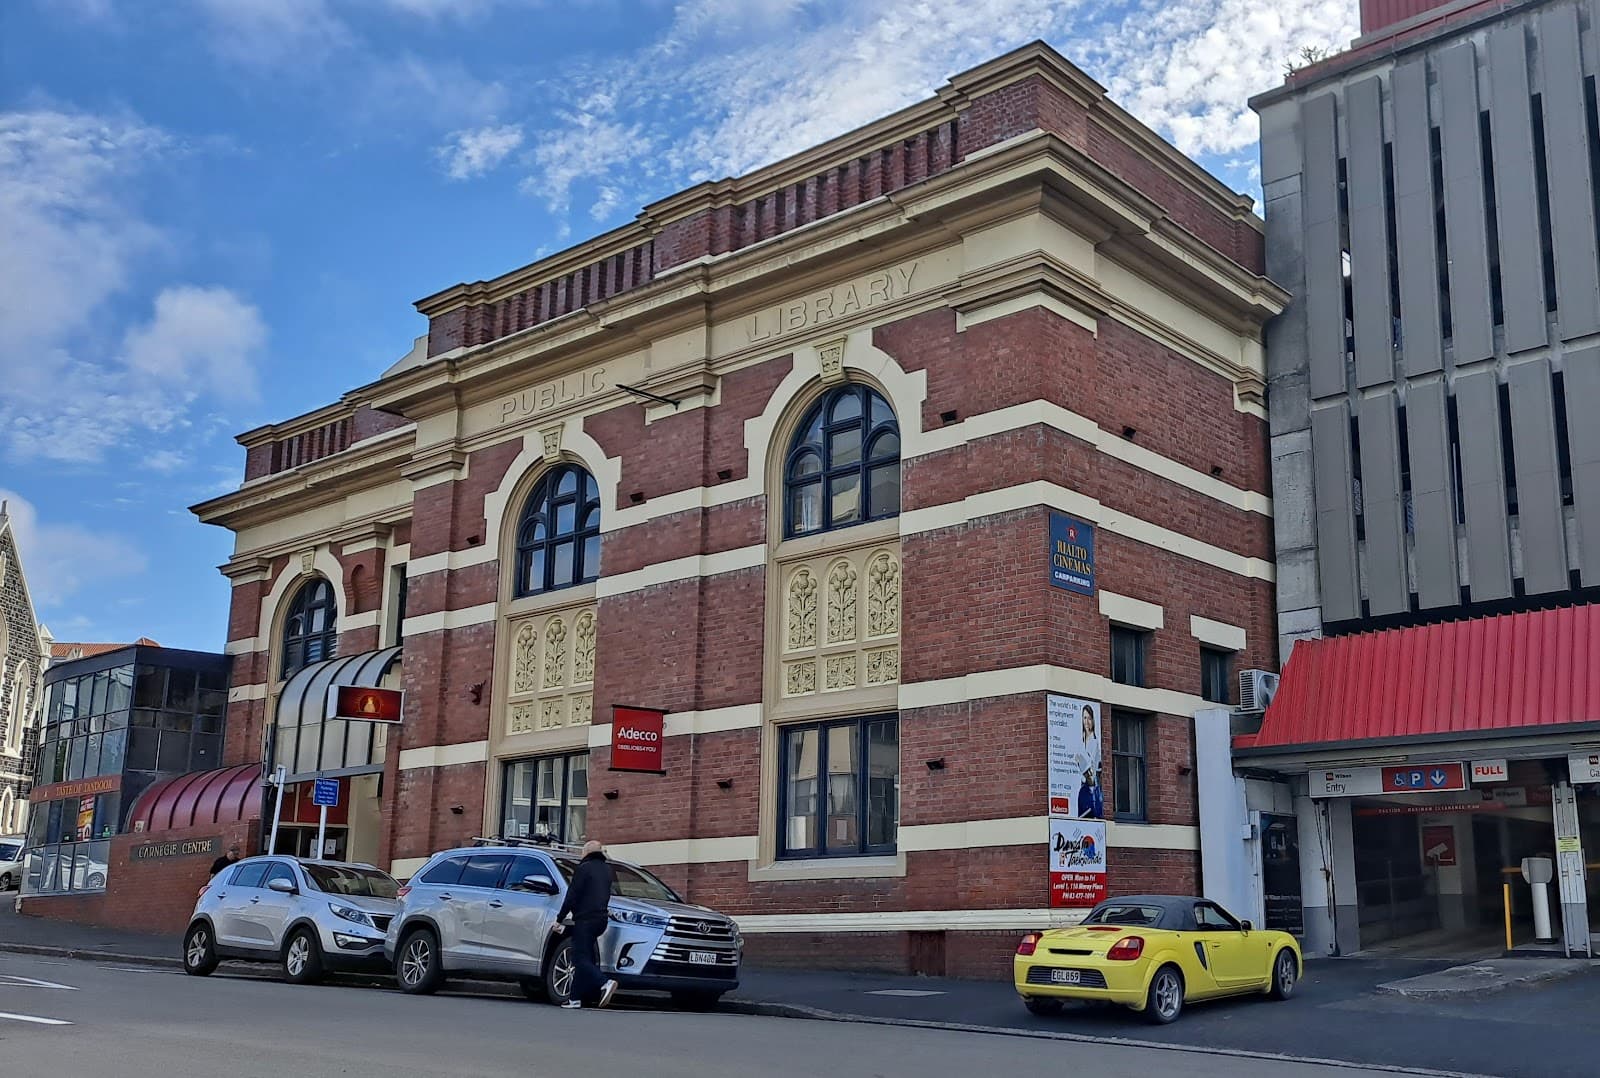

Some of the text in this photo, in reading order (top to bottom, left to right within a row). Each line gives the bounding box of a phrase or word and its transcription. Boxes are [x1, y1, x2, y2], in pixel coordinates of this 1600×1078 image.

[749, 263, 918, 341] LIBRARY
[501, 369, 606, 422] PUBLIC
[1057, 540, 1087, 560] RIALTO
[1053, 554, 1091, 575] CINEMAS
[617, 726, 658, 742] Adecco
[1474, 765, 1504, 776] FULL
[55, 779, 113, 797] TASTE OF TANDOOR
[1325, 783, 1346, 793] Entry
[138, 840, 212, 858] CARNEGIE CENTRE
